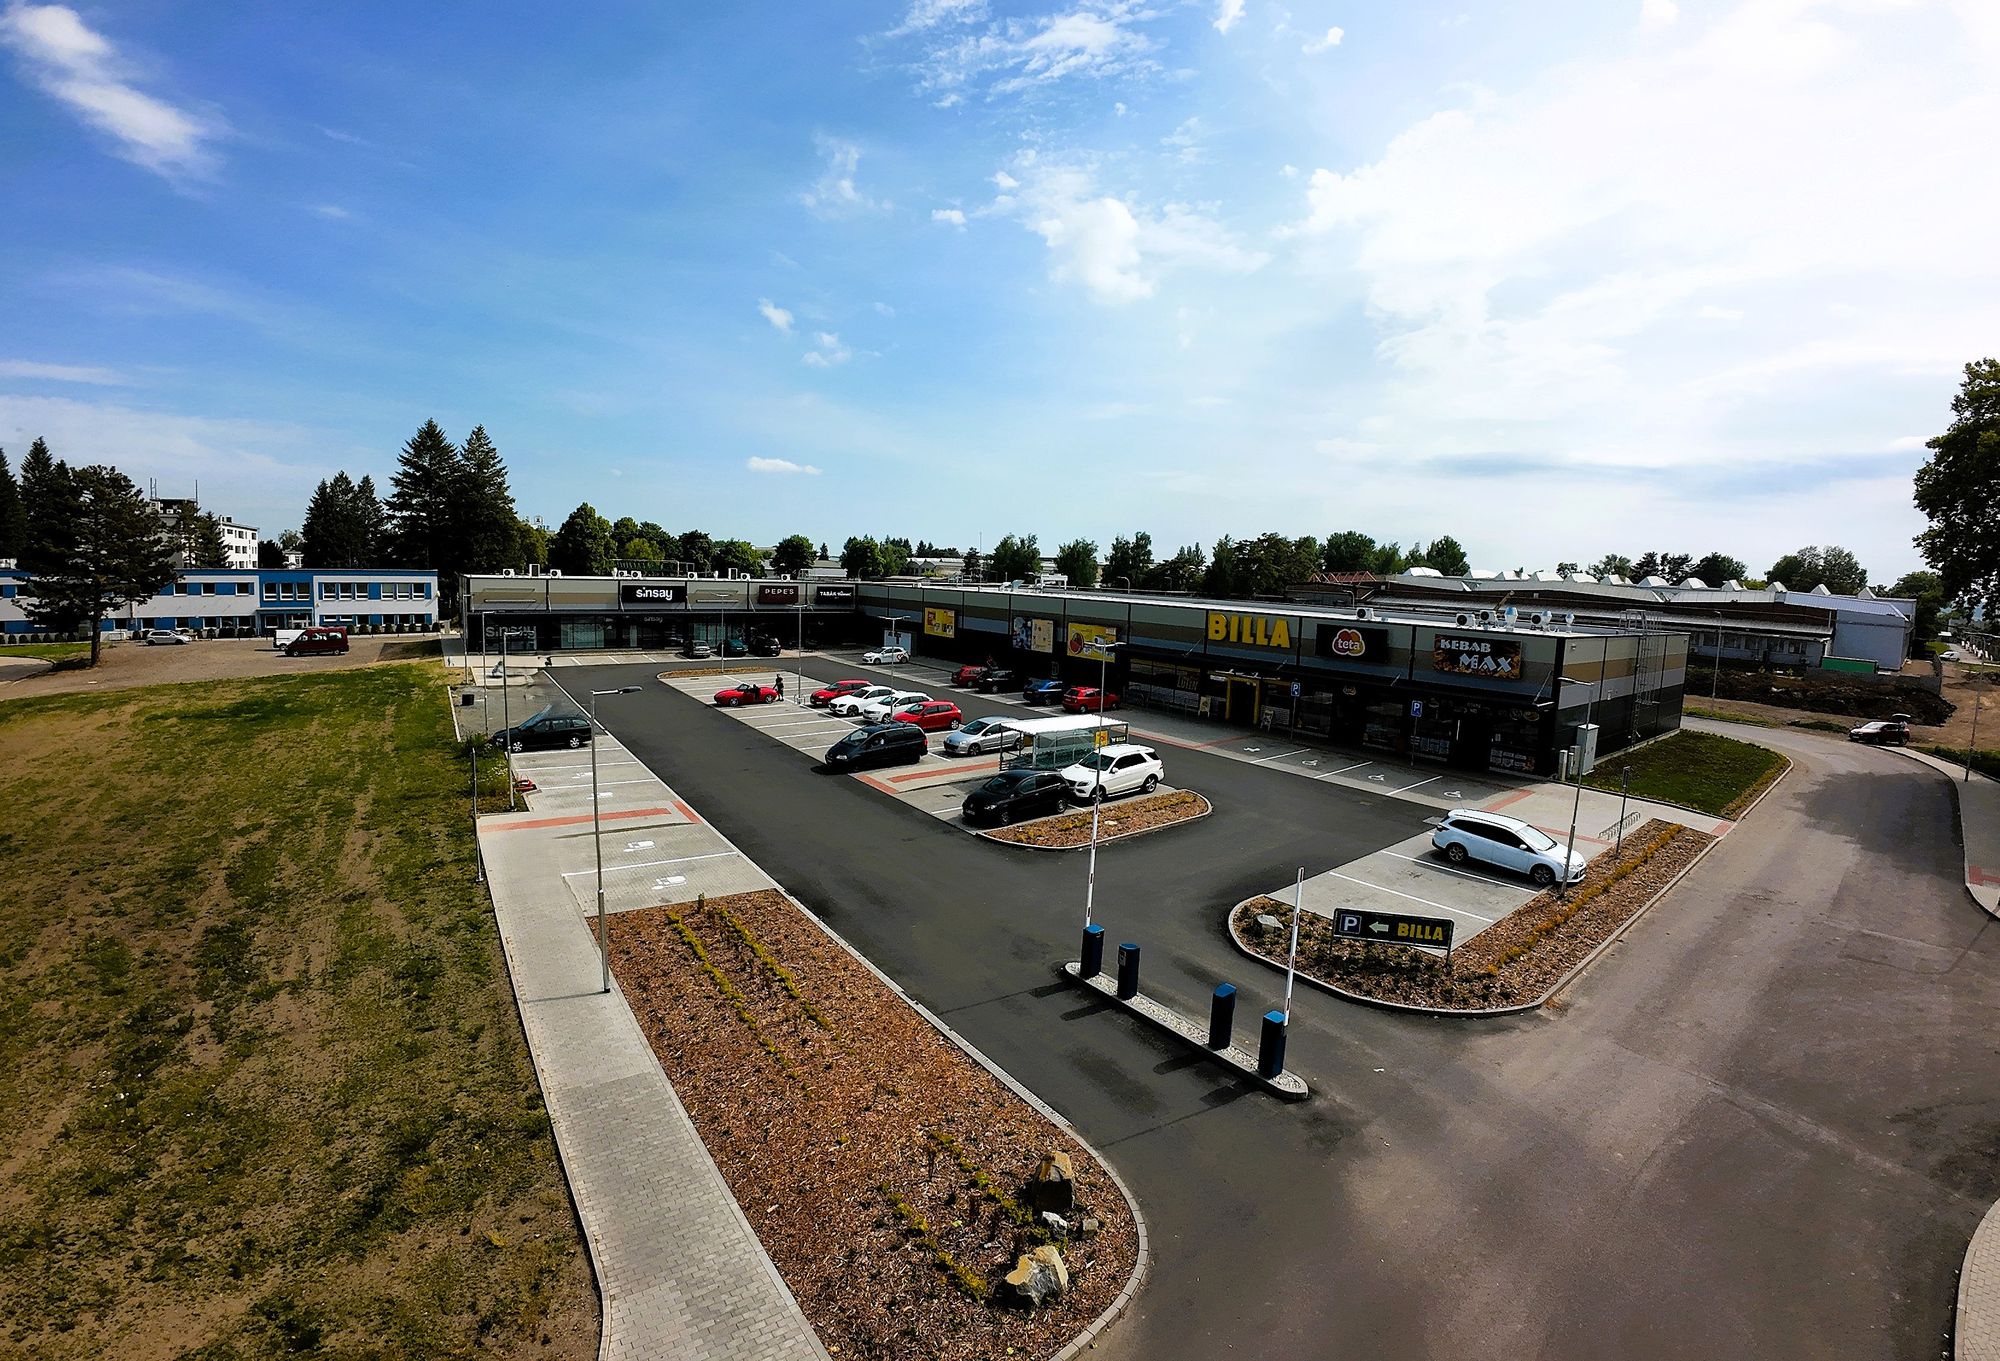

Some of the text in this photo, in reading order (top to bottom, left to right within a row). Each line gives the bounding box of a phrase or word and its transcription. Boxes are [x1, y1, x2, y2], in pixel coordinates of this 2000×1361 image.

[636, 587, 672, 600] sinsay
[1208, 613, 1290, 648] BILLA
[1337, 638, 1360, 650] teta
[1440, 639, 1491, 653] KEBAB
[1459, 653, 1511, 672] MAX
[1343, 916, 1443, 941] P BILLA
